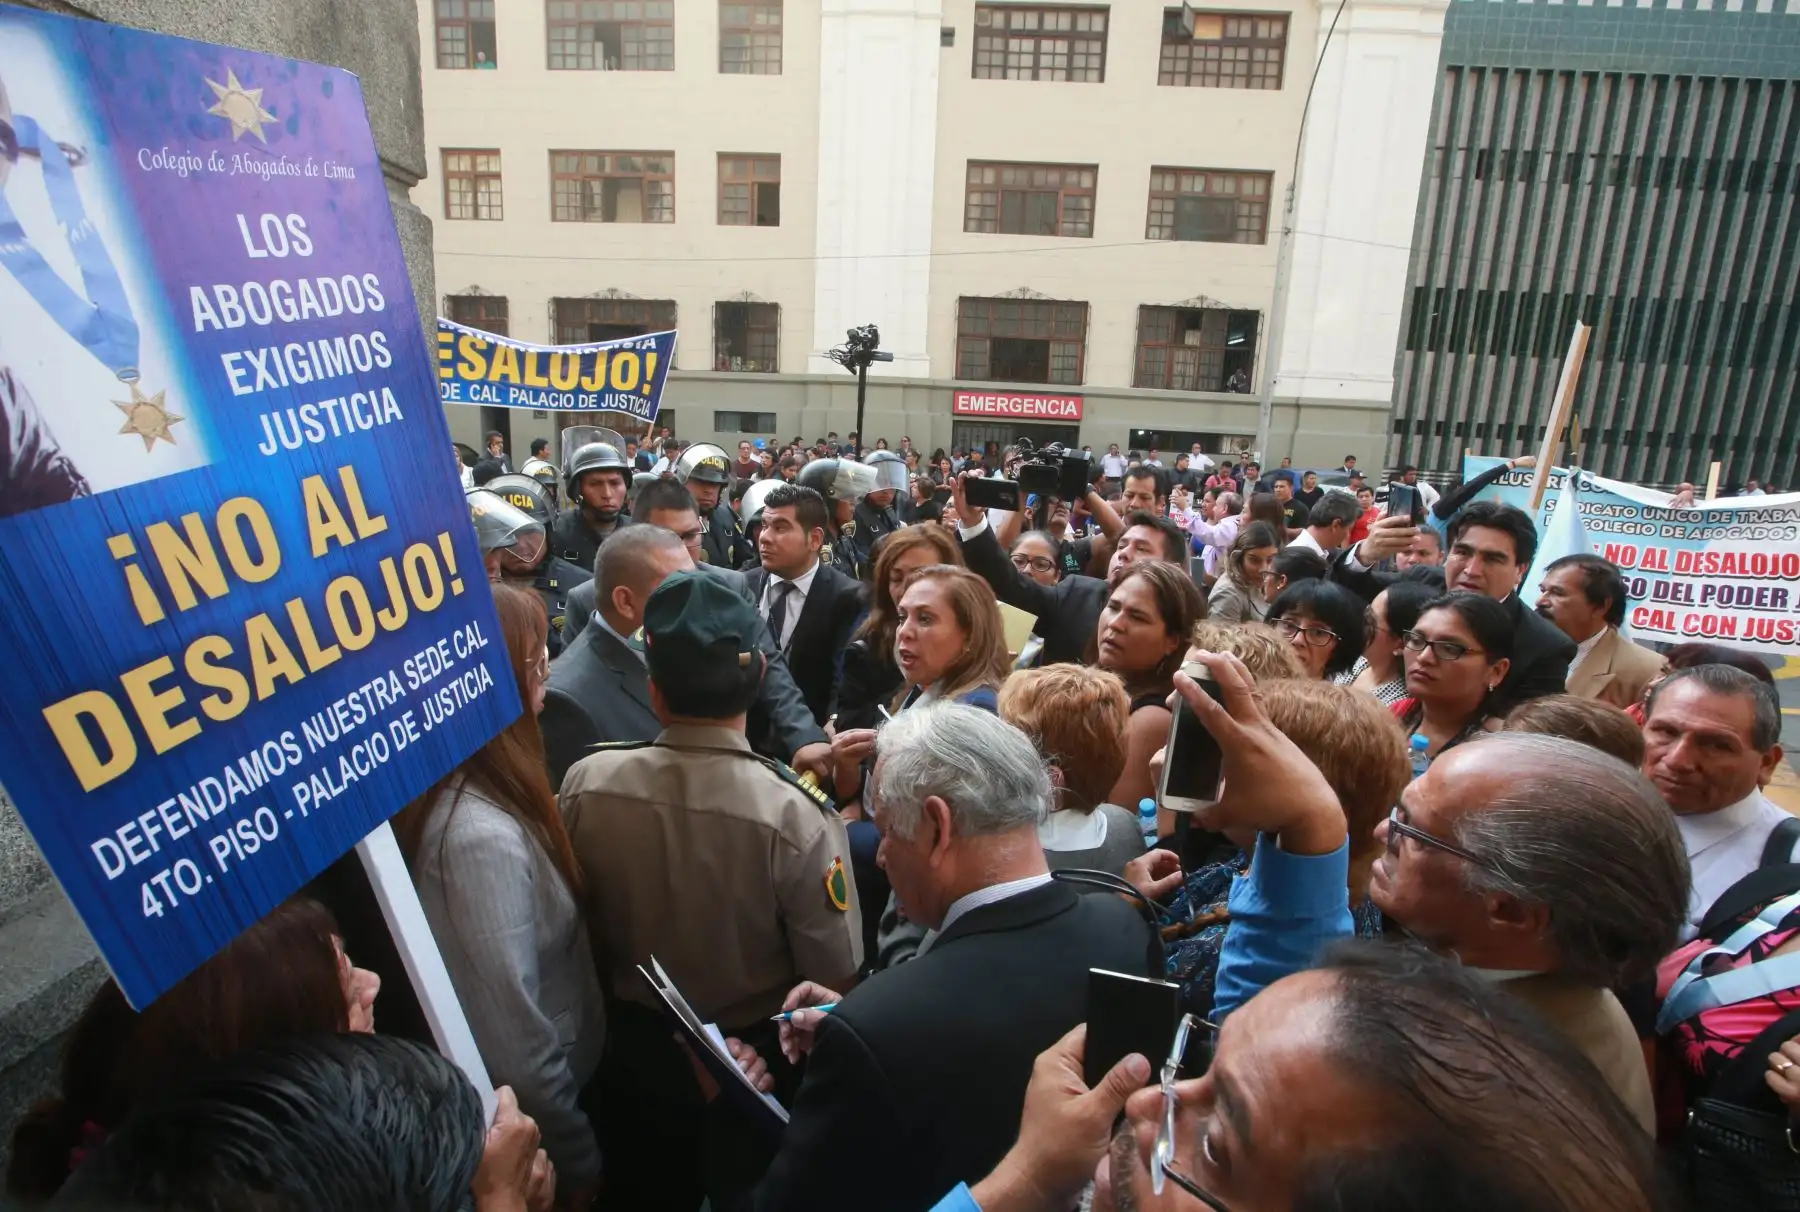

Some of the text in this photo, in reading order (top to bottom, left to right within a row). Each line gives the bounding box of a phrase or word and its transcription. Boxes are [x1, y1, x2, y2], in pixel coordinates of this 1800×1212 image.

[138, 147, 356, 181] Colegio de Abogados de Lima
[236, 213, 314, 258] LOS
[189, 273, 386, 332] ABOGADOS
[220, 331, 392, 397] EXIGIMOS
[437, 332, 658, 396] ESALOJO!
[469, 384, 502, 403] CAL
[509, 387, 575, 408] PALACIO
[578, 394, 598, 408] DE
[601, 393, 651, 417] JUSTICIA
[958, 395, 1078, 416] EMERGENCIA
[258, 386, 404, 456] JUSTICIA
[701, 456, 725, 471] OLICIA
[1544, 498, 1638, 519] SDICATO
[1707, 510, 1732, 524] DE
[1736, 509, 1800, 524] TRABA
[1583, 518, 1797, 541] COLEGIO DE ABOGADOS
[106, 464, 388, 626] ¡NO AL
[1640, 547, 1669, 572] AL
[1674, 551, 1800, 579] DESALOJO
[1652, 579, 1694, 604] DEL
[1701, 584, 1789, 609] PODER
[1632, 607, 1676, 631] CAL
[1683, 613, 1738, 638] CON
[42, 531, 465, 794] DESALOJO!
[91, 620, 488, 880] DEFENDAMOS NUESTRA SEDE CAL
[141, 858, 214, 918] 4TO.
[209, 807, 279, 873] PISO
[292, 732, 390, 818] PALACIO
[389, 710, 421, 752] DE
[423, 663, 494, 730] JUSTICIA
